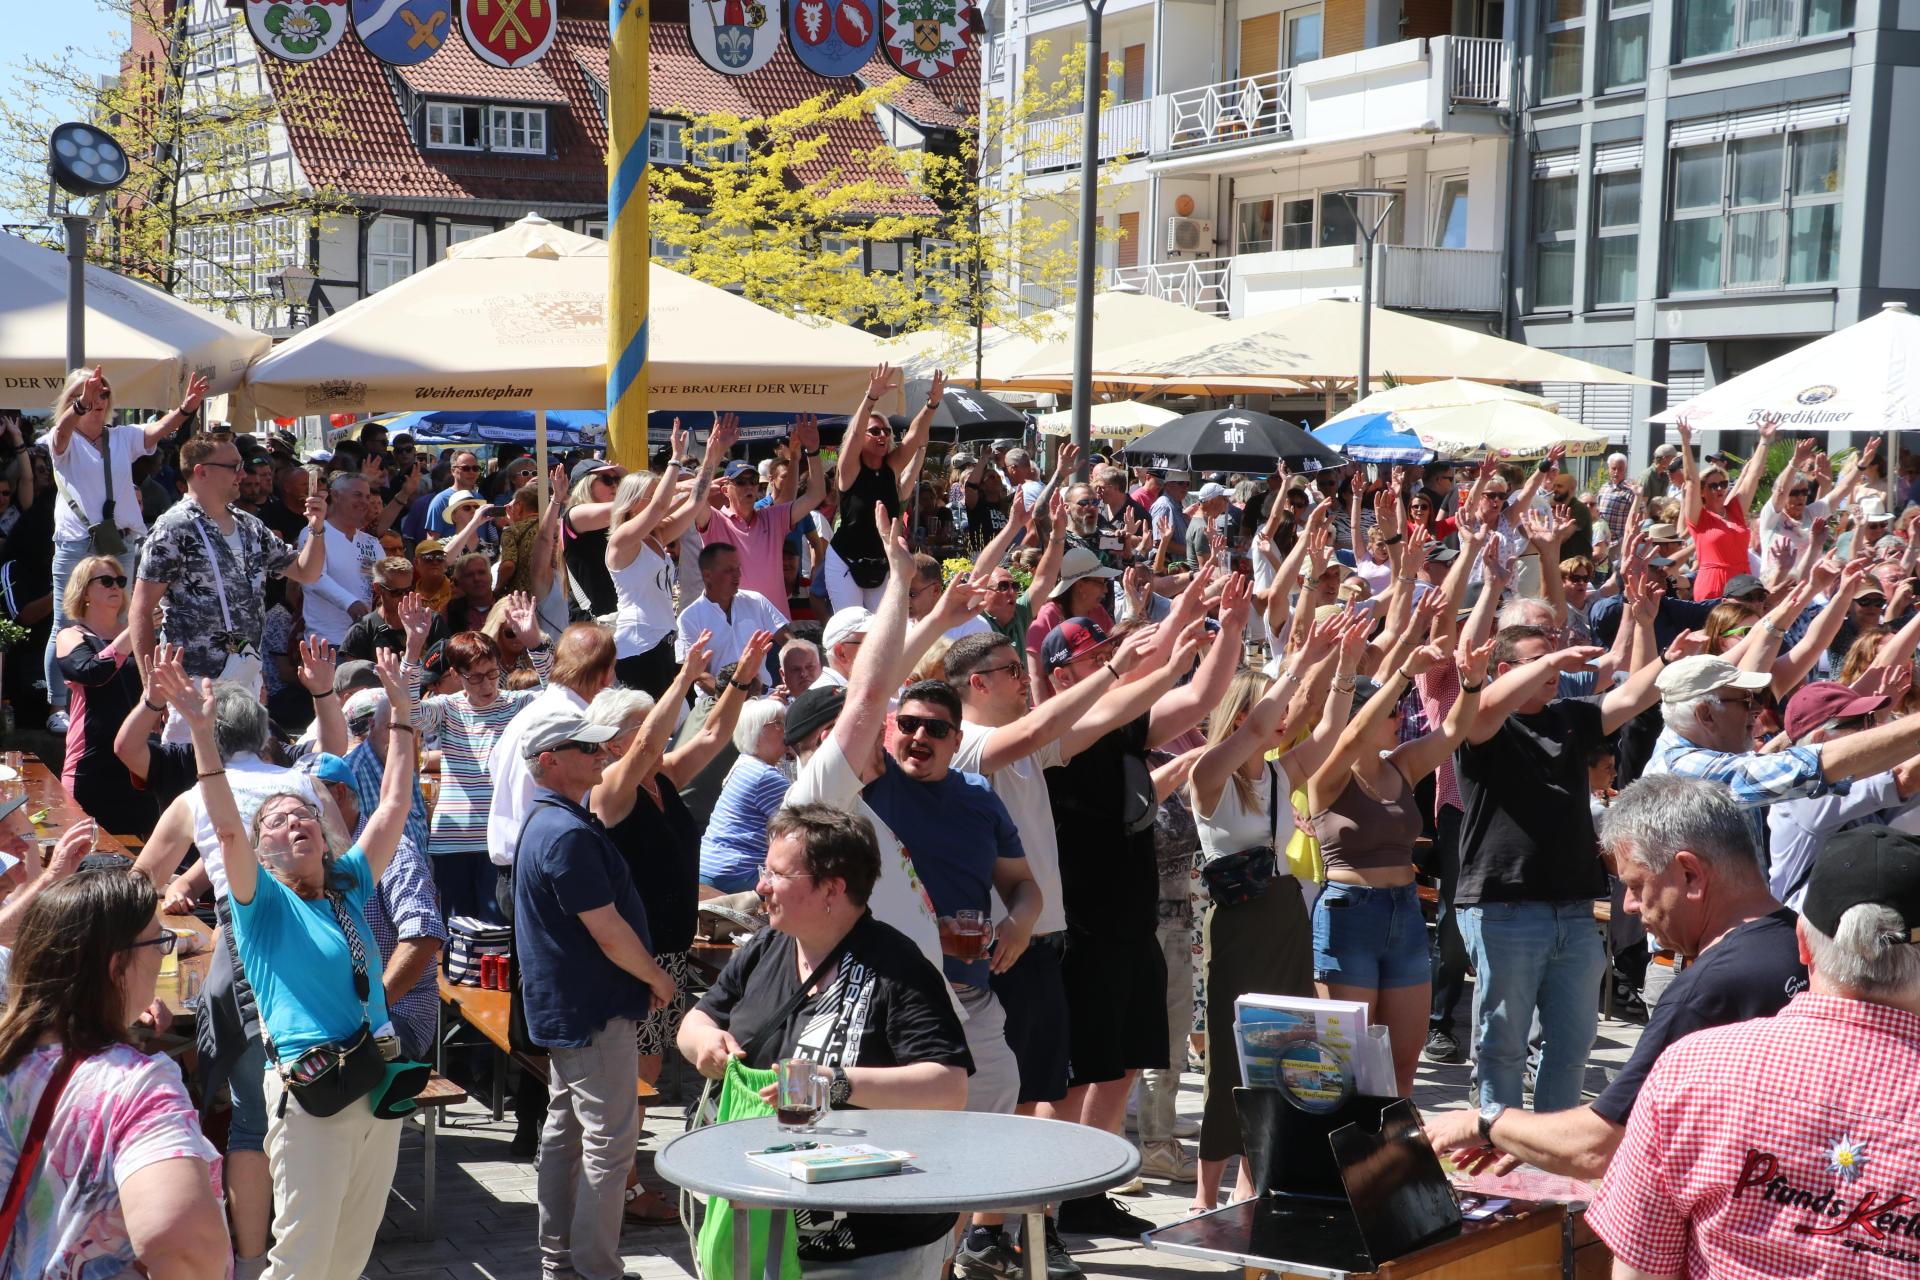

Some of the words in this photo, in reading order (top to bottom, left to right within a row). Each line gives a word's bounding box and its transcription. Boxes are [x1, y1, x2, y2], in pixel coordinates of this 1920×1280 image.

[5, 377, 41, 389] DER
[682, 384, 752, 394] BRAUEREI
[756, 383, 787, 394] DER
[789, 383, 830, 396] WELT
[414, 384, 534, 401] Weihenstephan
[1732, 1149, 1846, 1217] Pfunds
